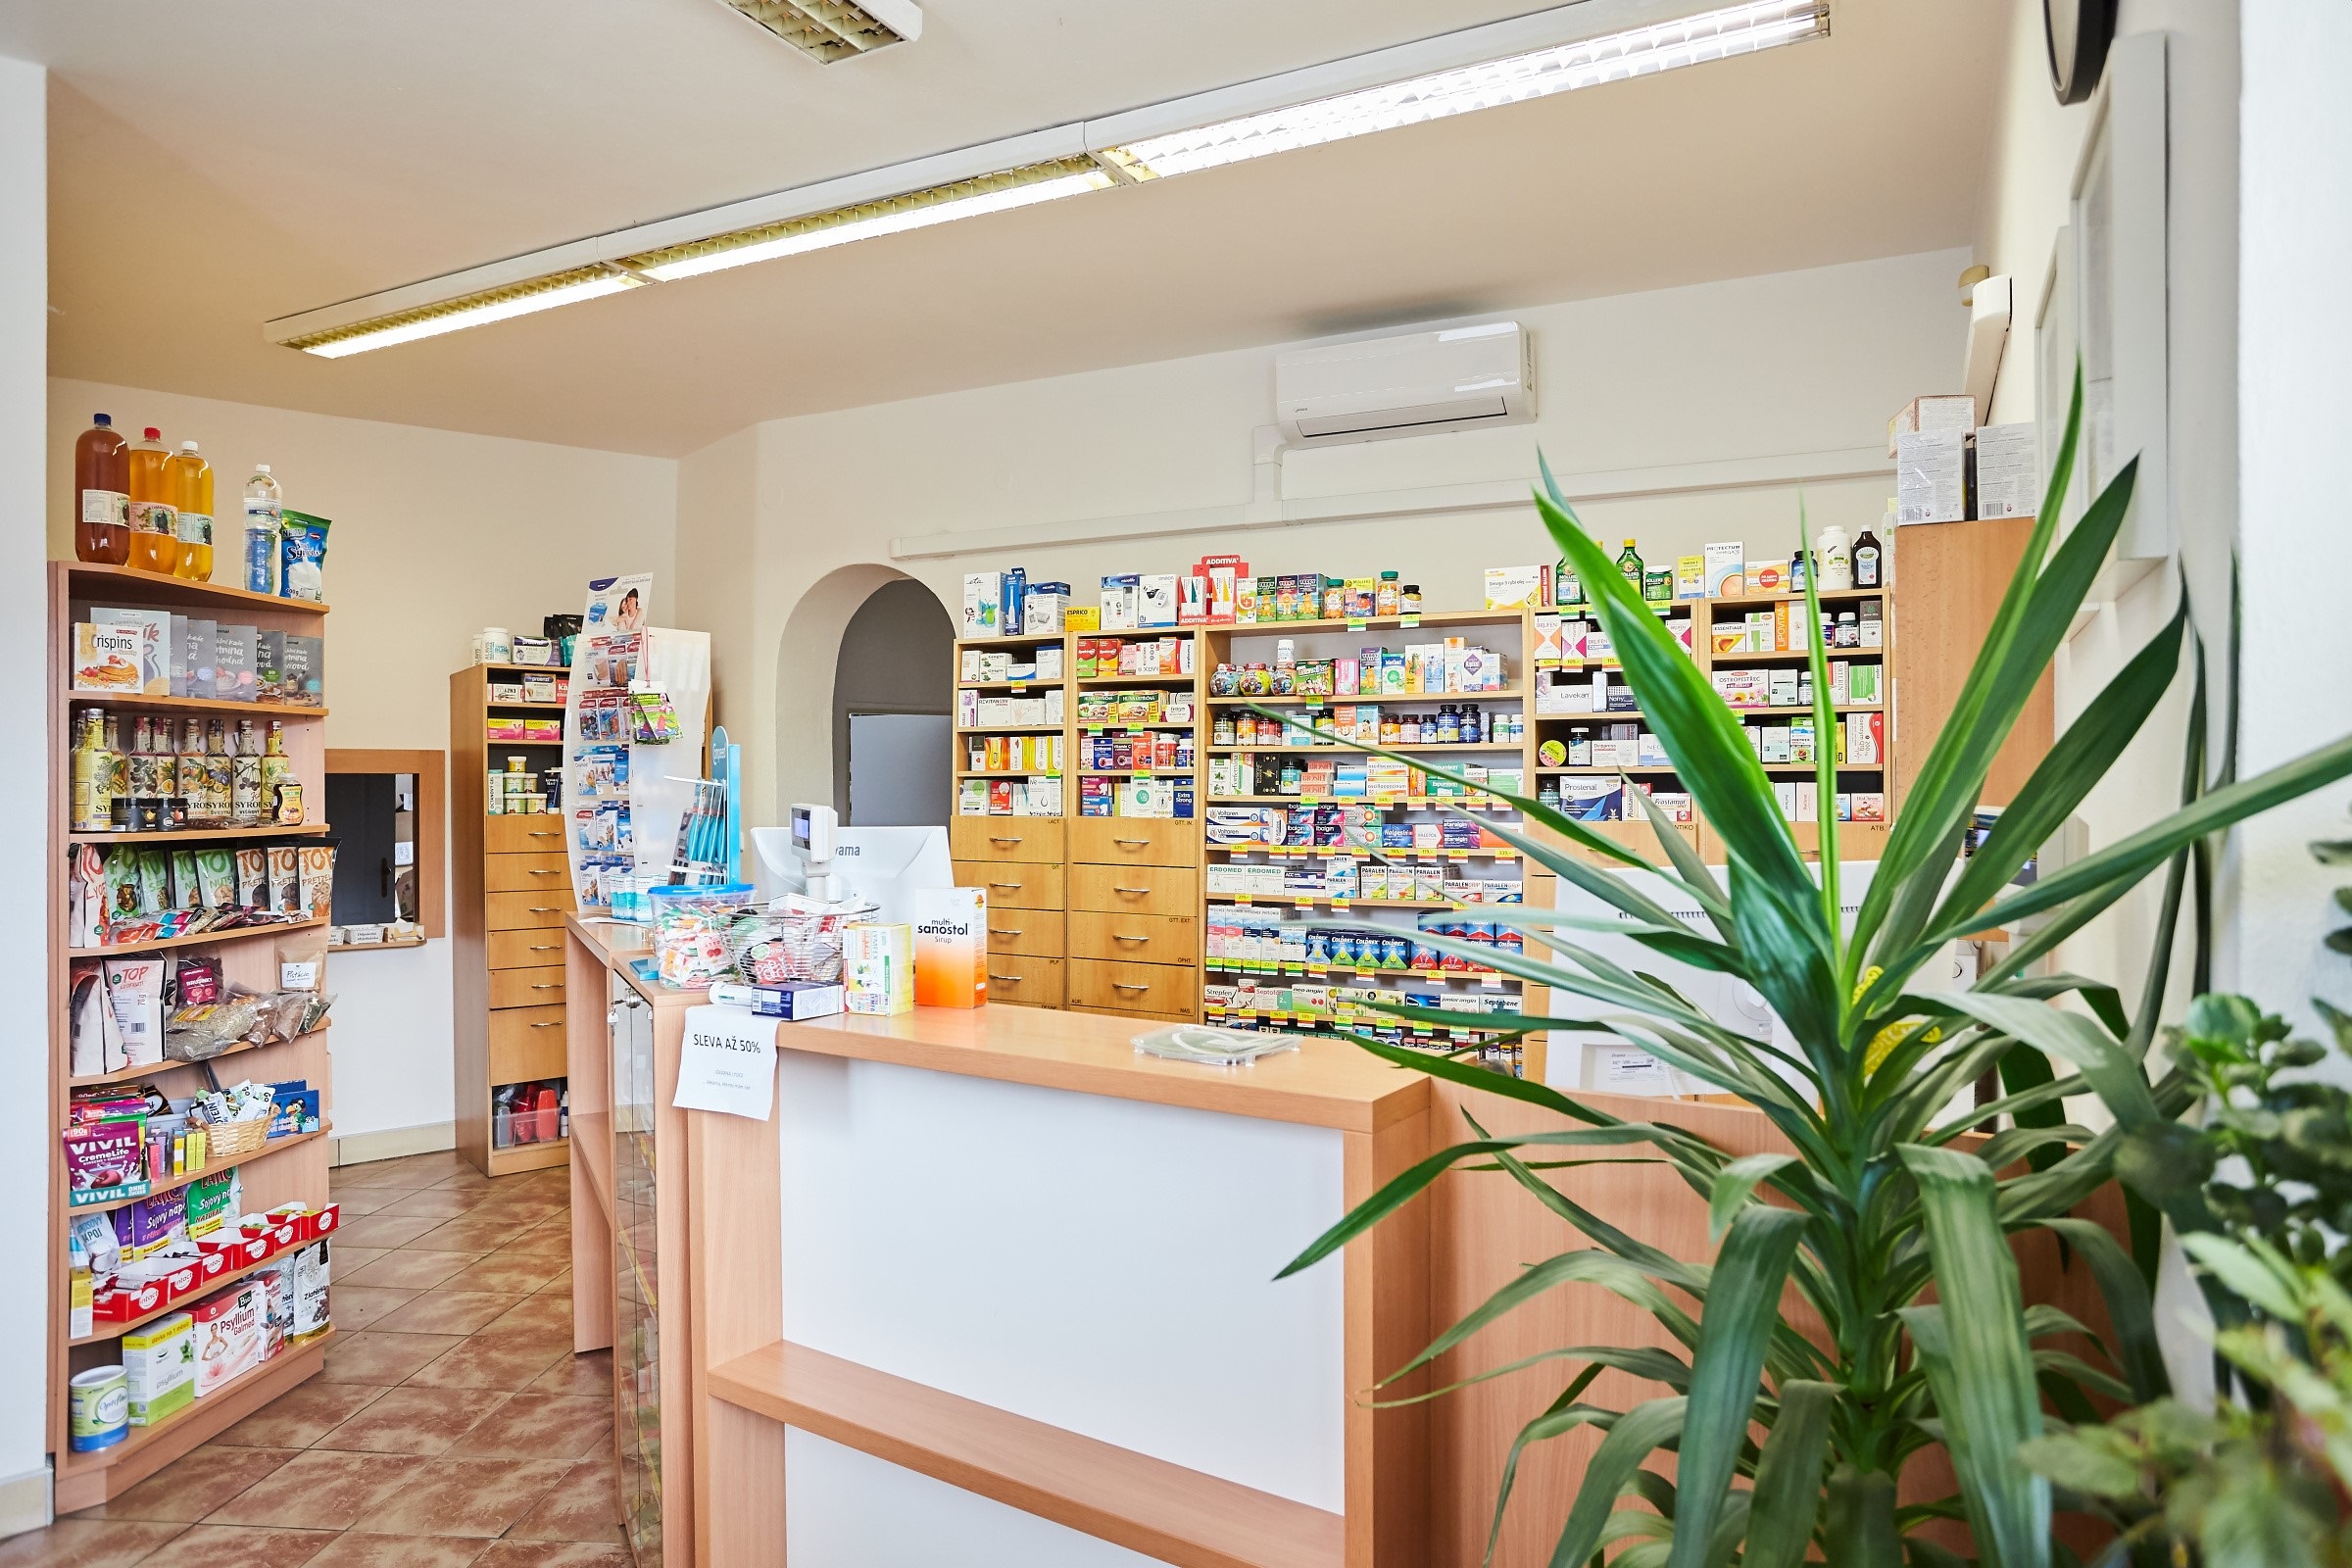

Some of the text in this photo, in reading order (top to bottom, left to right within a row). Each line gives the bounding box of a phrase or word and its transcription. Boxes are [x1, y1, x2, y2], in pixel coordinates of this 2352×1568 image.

[1777, 605, 1786, 648] LIPOVITAN
[91, 633, 133, 651] Crispins
[917, 922, 968, 936] sanostol
[931, 918, 954, 927] multi-
[934, 936, 953, 945] Sirup
[122, 966, 150, 983] TOP
[1206, 988, 1233, 998] Strepfen
[693, 1033, 761, 1054] SLEVA AŽ 50%
[70, 1137, 137, 1156] VIVIL
[78, 1148, 130, 1163] CremeLife
[75, 1191, 125, 1204] VIVIL
[220, 1307, 256, 1334] Psyllium
[157, 1369, 184, 1390] psyllium
